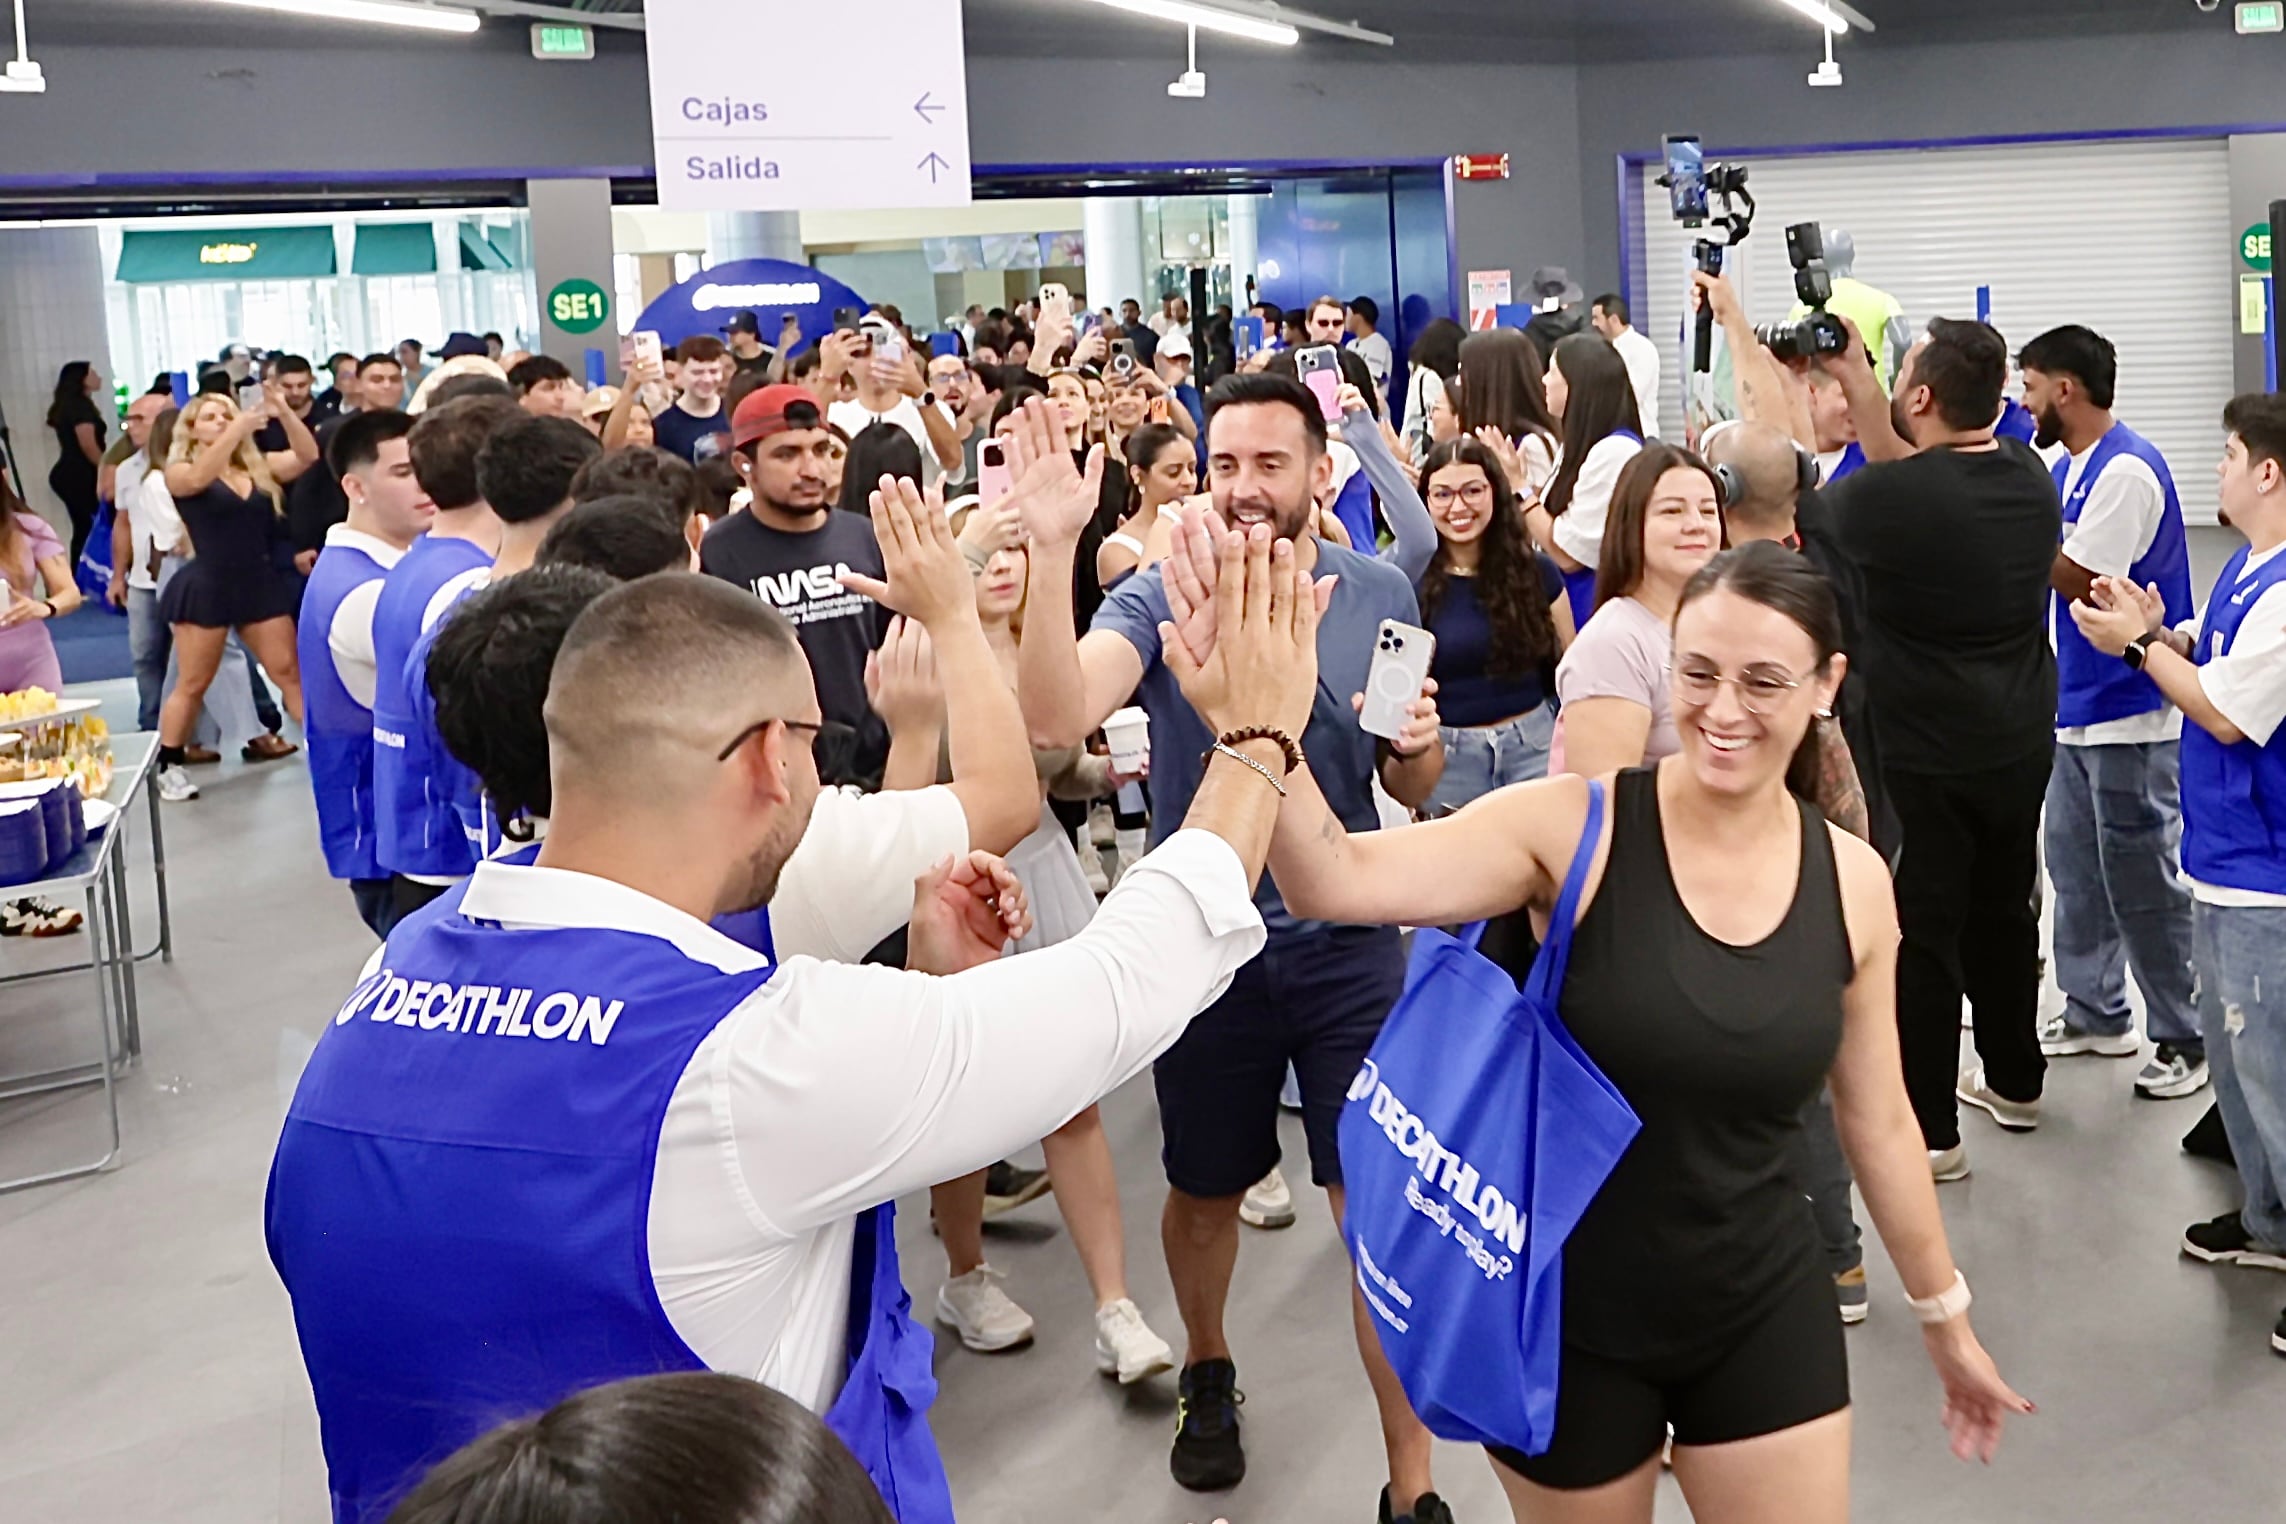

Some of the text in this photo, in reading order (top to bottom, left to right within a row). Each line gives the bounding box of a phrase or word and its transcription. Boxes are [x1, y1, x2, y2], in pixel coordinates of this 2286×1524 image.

[682, 96, 768, 127] Cajas
[686, 155, 780, 180] Salida
[2244, 235, 2272, 258] SE
[553, 292, 602, 321] SE1
[371, 976, 625, 1046] DECATHLON
[1369, 1080, 1528, 1255] DECATHLON
